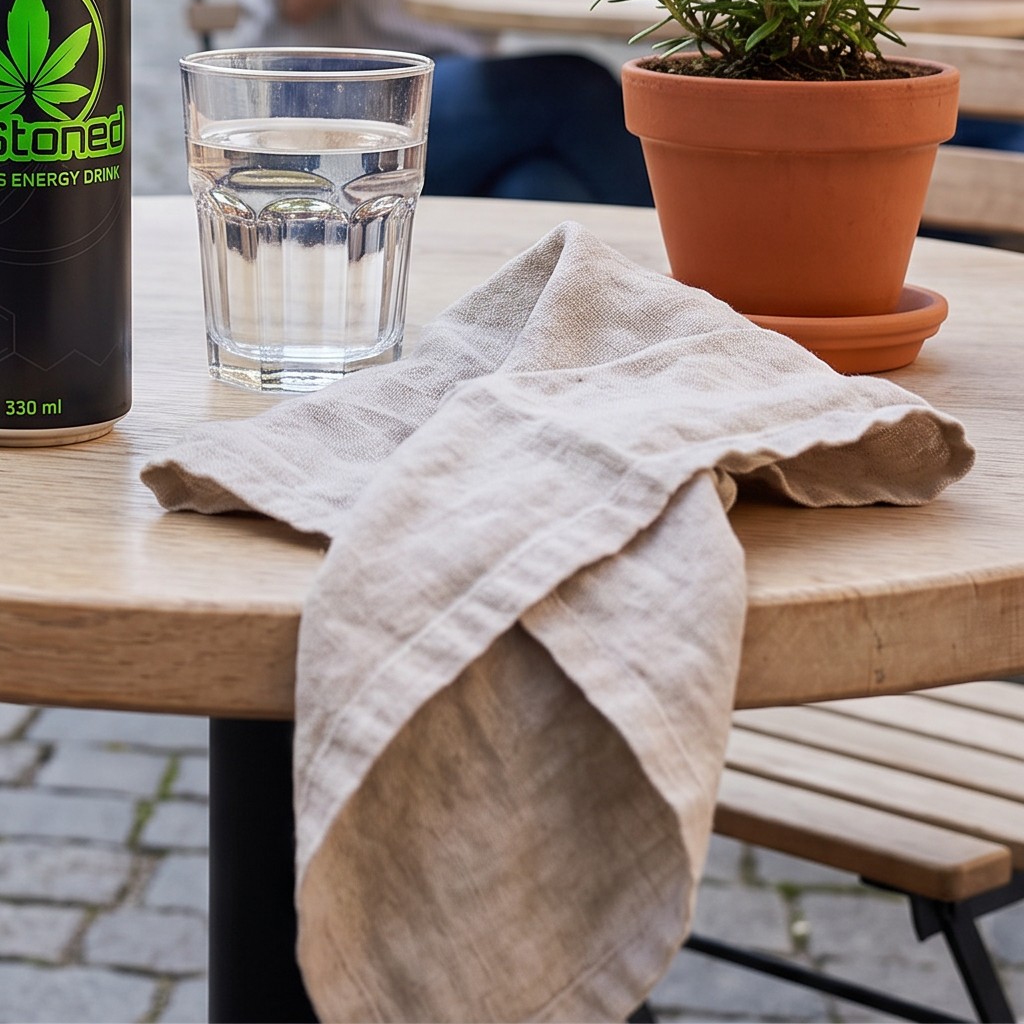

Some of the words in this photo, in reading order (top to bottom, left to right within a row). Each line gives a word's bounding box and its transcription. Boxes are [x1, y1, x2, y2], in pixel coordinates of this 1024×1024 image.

[11, 171, 80, 187] ENERGY
[83, 165, 120, 185] DRINK
[5, 400, 37, 416] 330
[42, 398, 62, 415] ml
